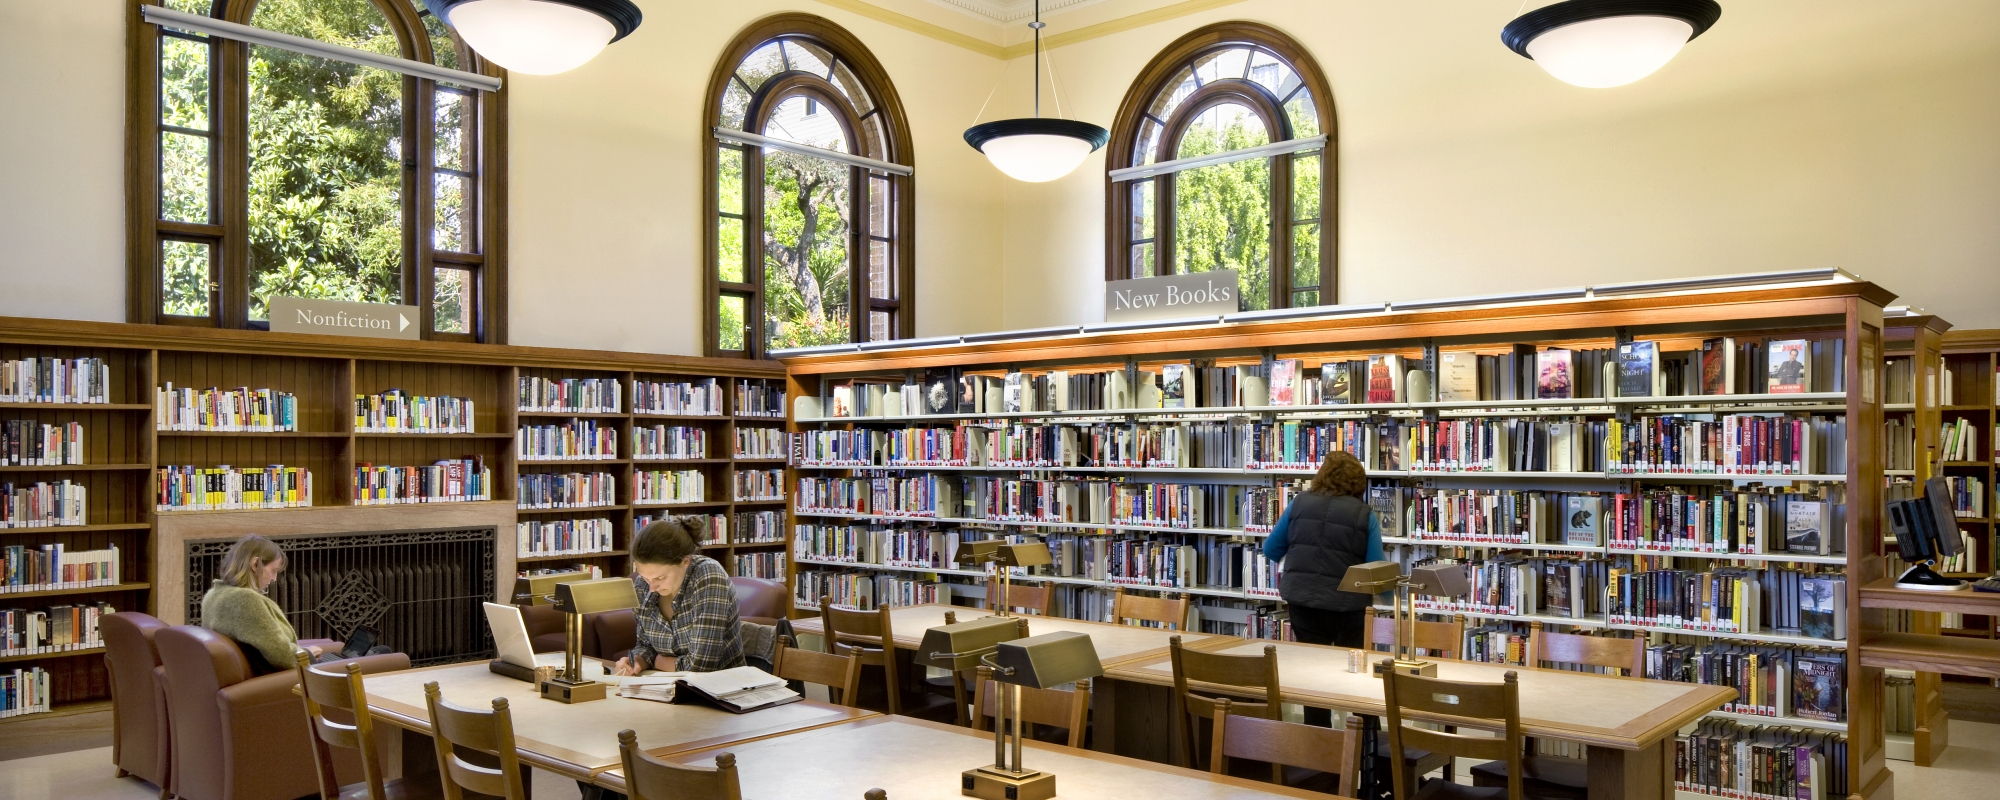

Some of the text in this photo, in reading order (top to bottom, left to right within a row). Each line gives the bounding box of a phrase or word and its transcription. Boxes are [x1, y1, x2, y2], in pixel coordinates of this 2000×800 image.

[1114, 280, 1230, 310] New Books
[296, 309, 391, 330] Nonfiction
